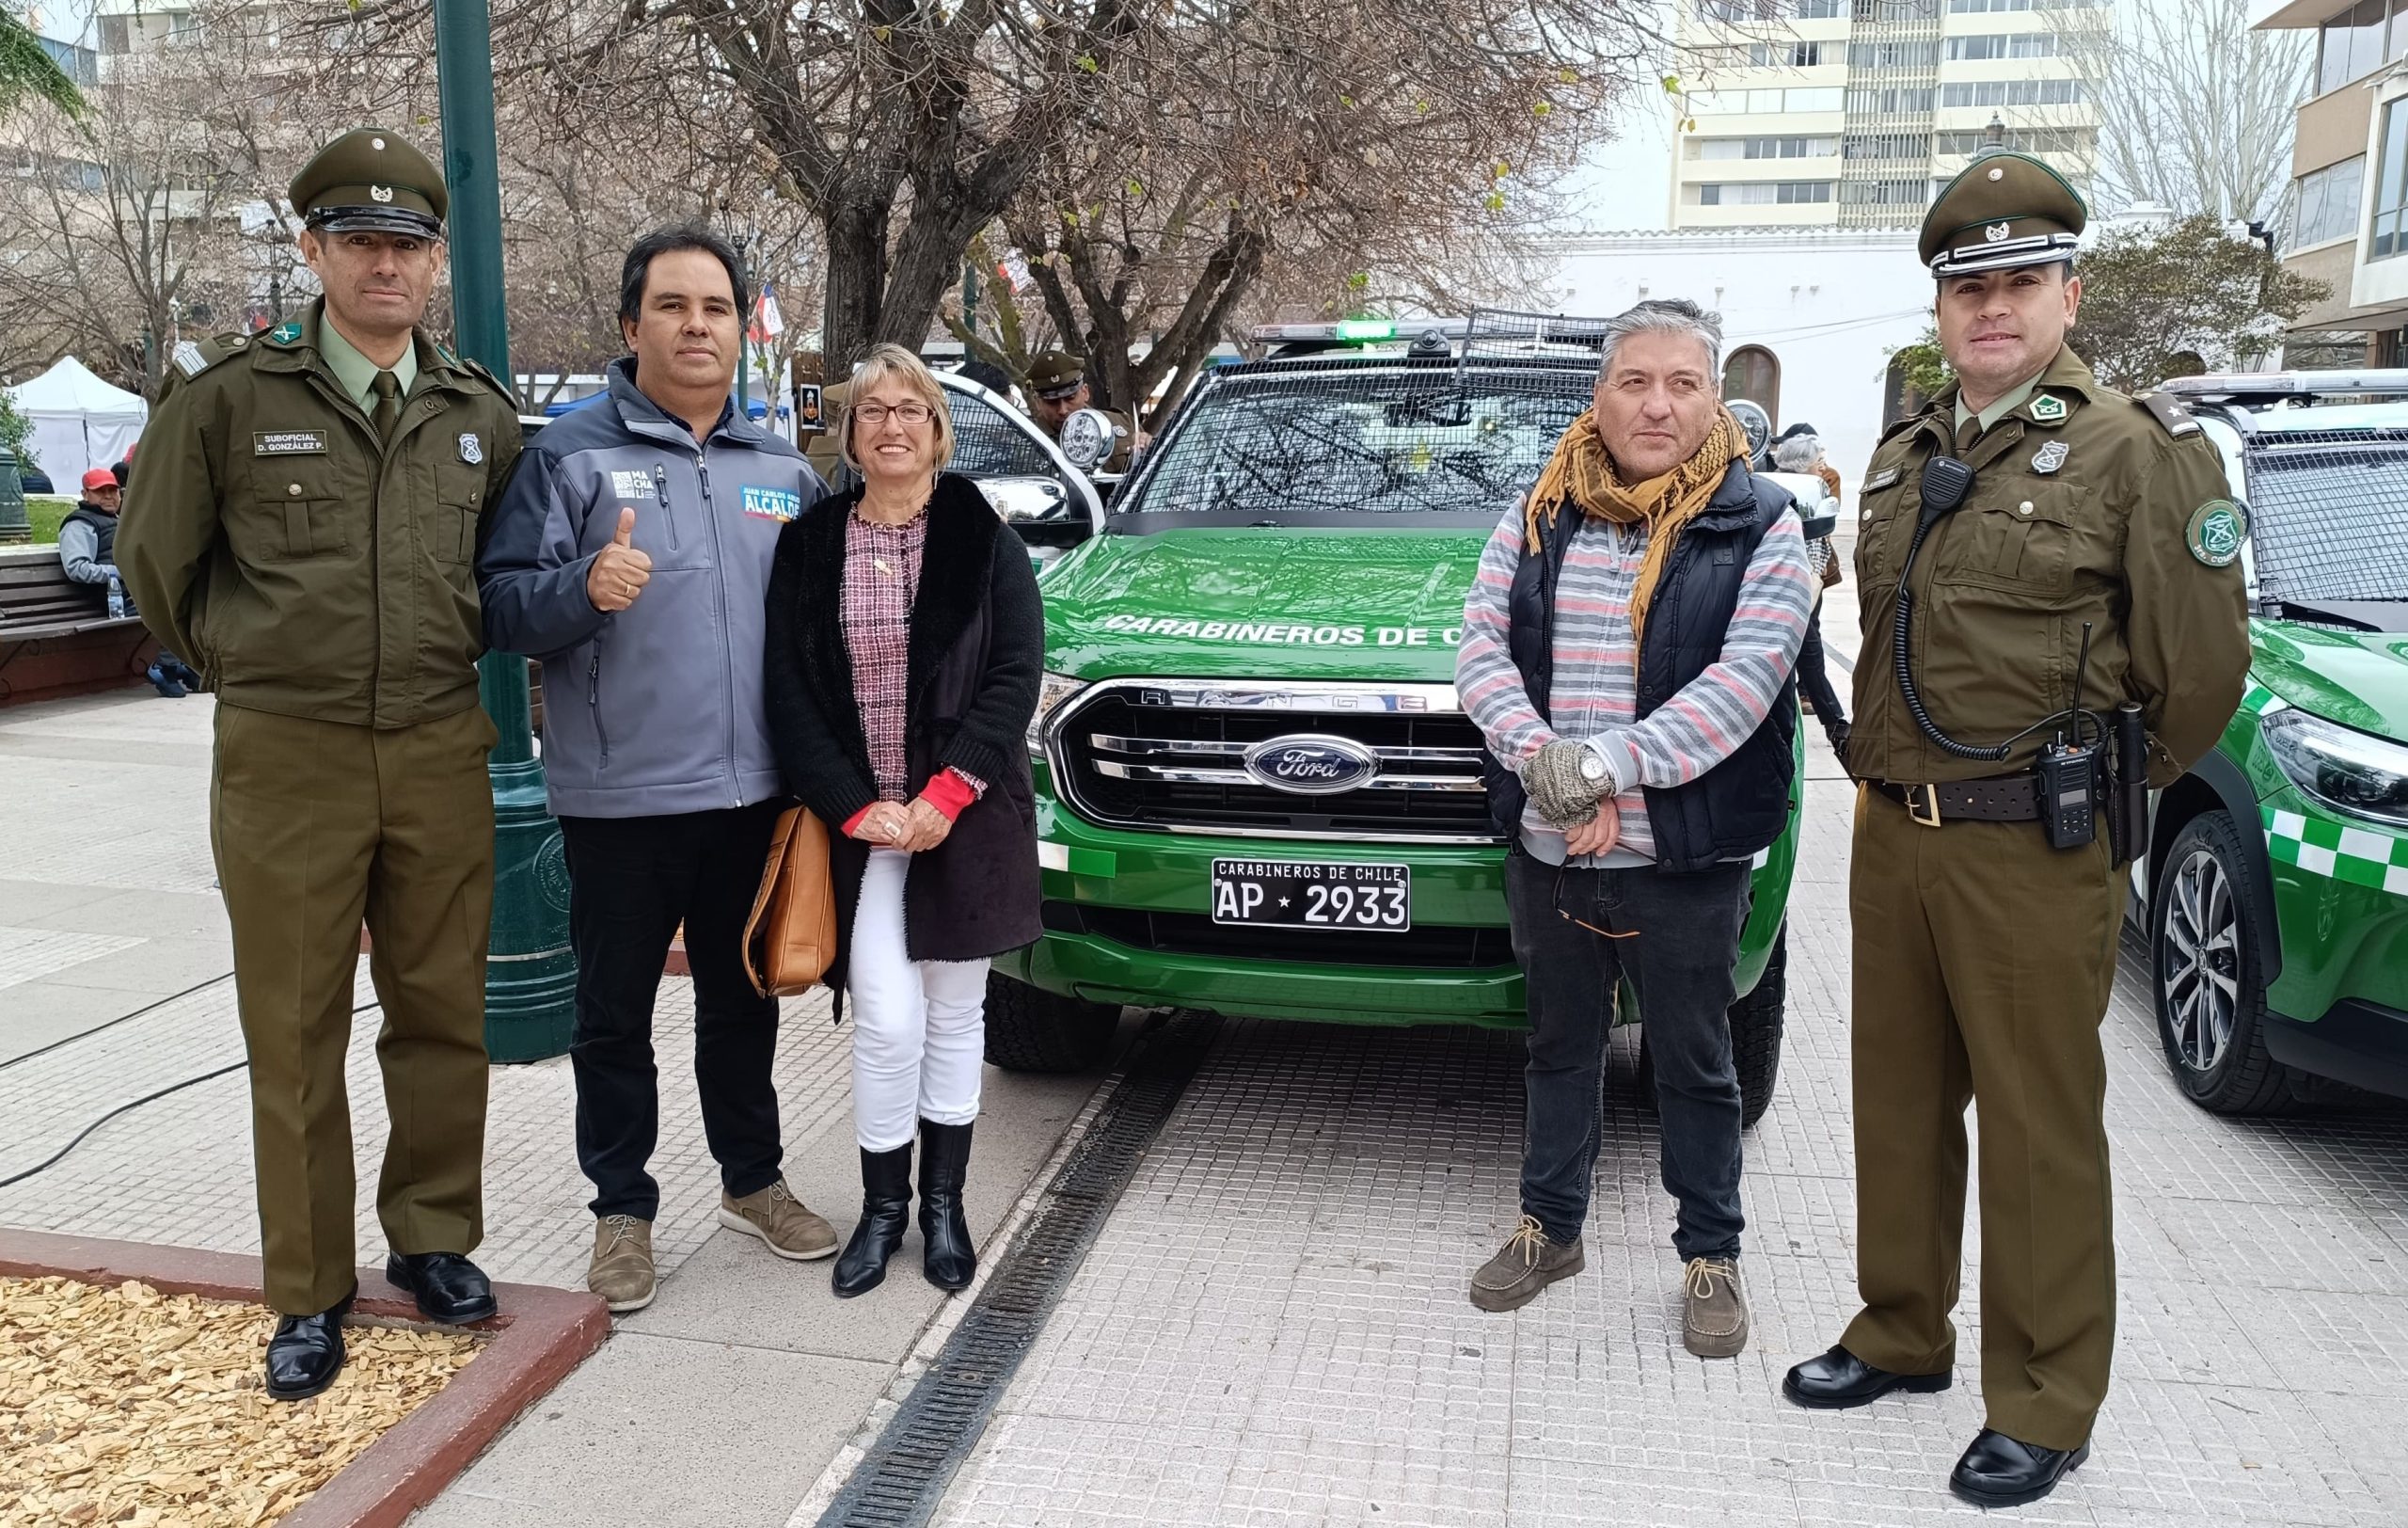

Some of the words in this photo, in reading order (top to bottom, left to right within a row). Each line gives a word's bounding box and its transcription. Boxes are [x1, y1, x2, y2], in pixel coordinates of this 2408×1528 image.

[264, 434, 317, 442] SUBOFICIAL
[268, 441, 315, 451] GONZÁLEZ
[631, 470, 649, 480] MA
[633, 480, 655, 489] CHA
[745, 494, 800, 520] ALCALDE
[1104, 614, 1364, 646] CARABINEROS
[1378, 628, 1428, 646] DE
[1140, 689, 1428, 712] RANGE
[1275, 749, 1342, 777] Ford
[1219, 863, 1321, 879] CARABINEROS
[1329, 867, 1347, 880] DE
[1355, 867, 1402, 882] CHILE
[1216, 881, 1264, 918] AP
[1305, 885, 1406, 926] 2933
